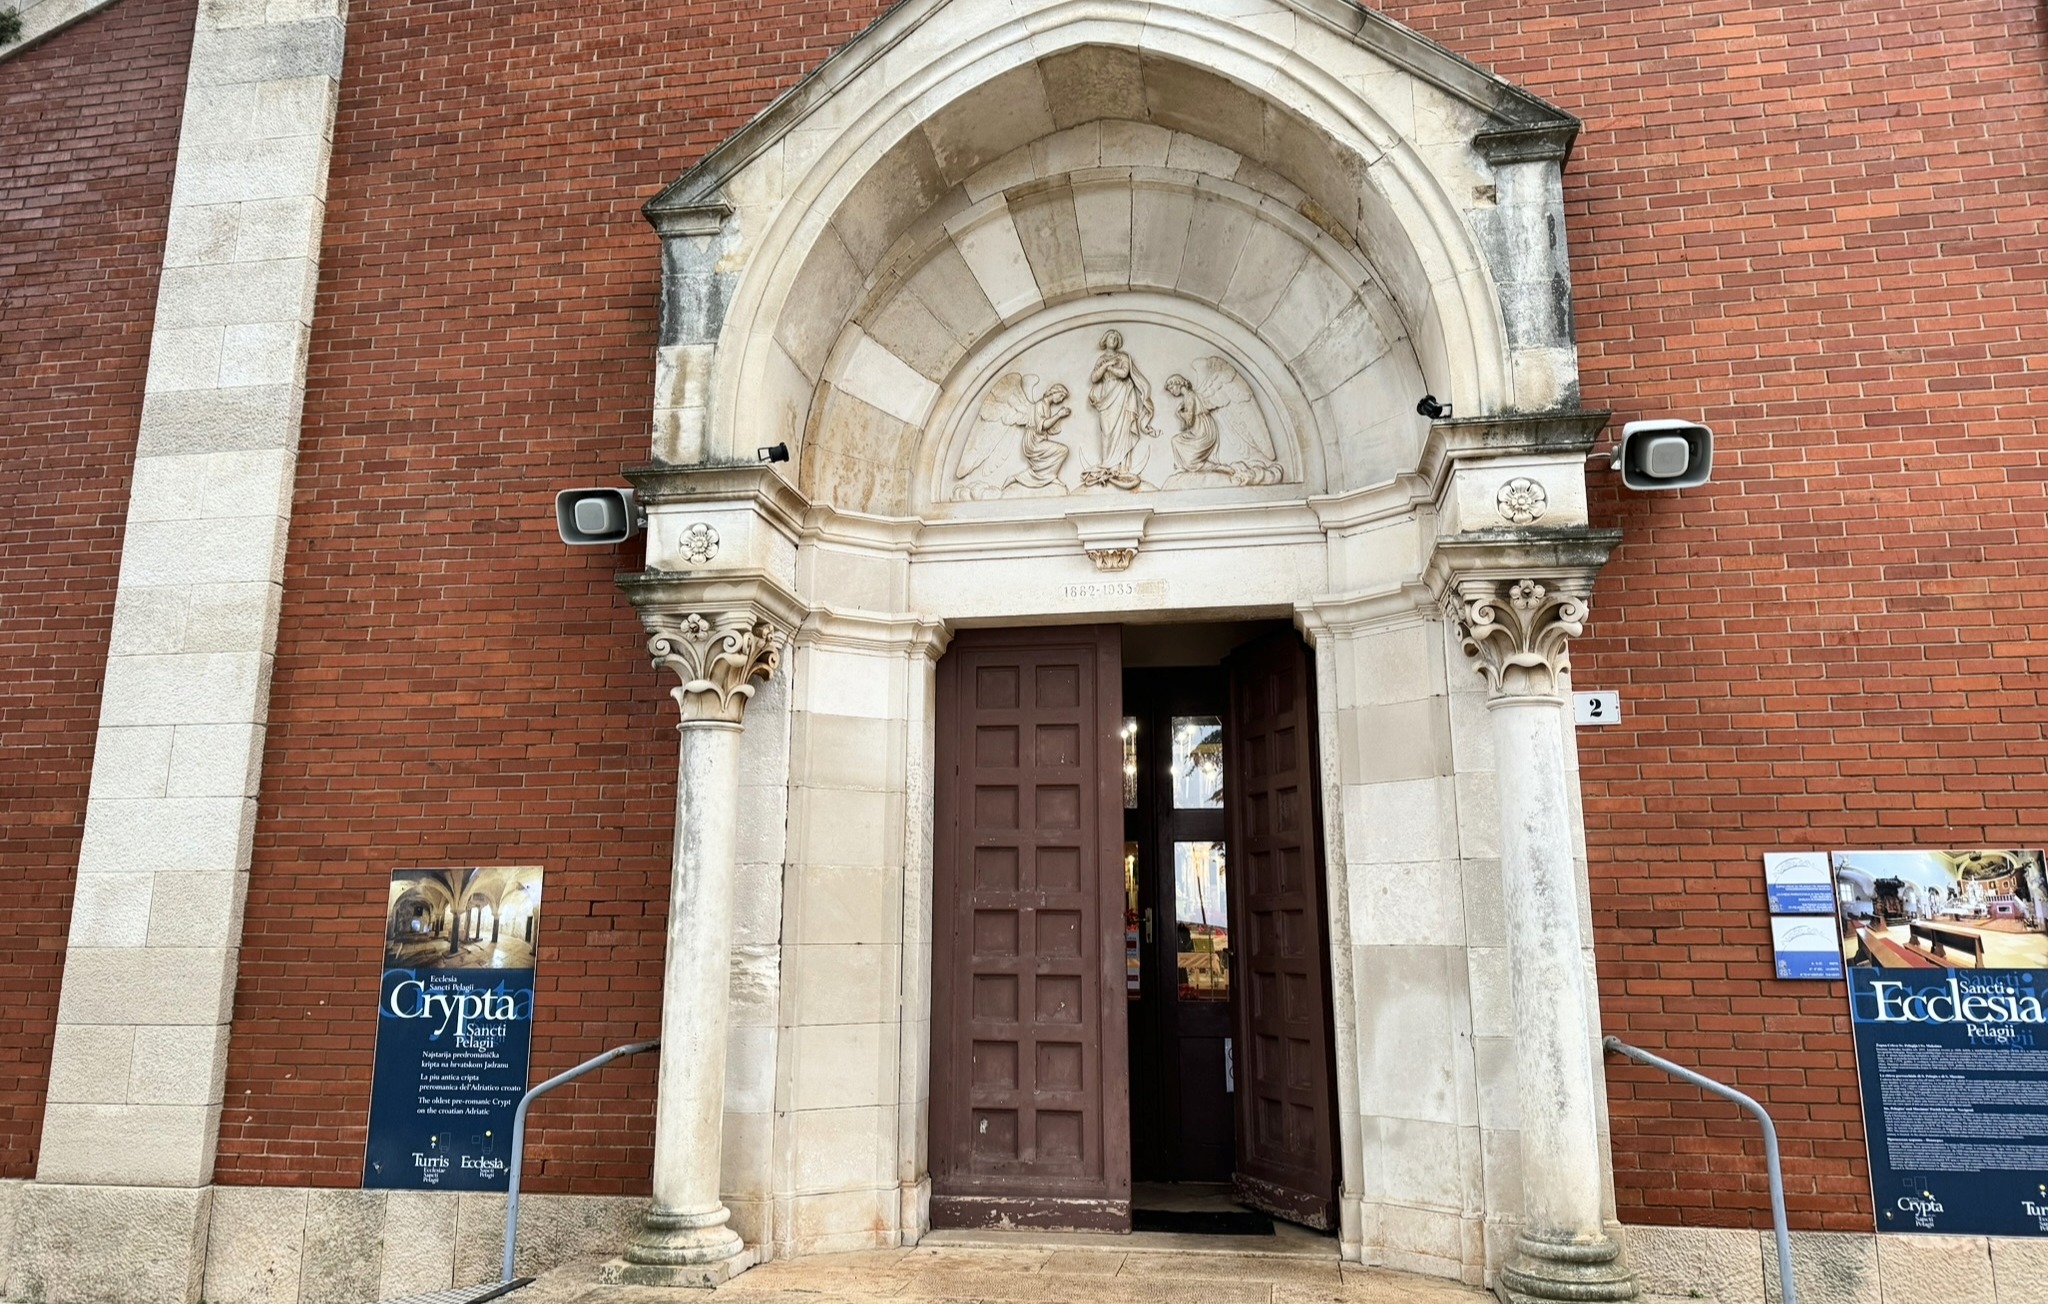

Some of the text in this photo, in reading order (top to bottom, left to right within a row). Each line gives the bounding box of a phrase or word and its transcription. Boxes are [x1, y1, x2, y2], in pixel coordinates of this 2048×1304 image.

[1589, 698, 1603, 718] 2
[430, 975, 458, 983] Ecclesia
[429, 983, 474, 993] Sancti Pelagii
[1960, 980, 2005, 994] Sancti
[391, 980, 517, 1036] Crypta
[1869, 978, 2047, 1024] Ecclesia
[466, 1022, 506, 1037] Sancti
[1967, 1023, 2016, 1043] Pelagii
[456, 1035, 494, 1053] Pelagii
[422, 1051, 500, 1060] Najstarija predromanička
[421, 1060, 440, 1070] kripta
[484, 1061, 509, 1070] Jadranu
[460, 1074, 479, 1083] cripta
[419, 1084, 458, 1092] preromanica
[451, 1098, 491, 1106] pre-romanic
[492, 1098, 511, 1107] Crypt
[465, 1107, 490, 1115] Adriatic
[412, 1152, 450, 1168] Turris
[461, 1155, 504, 1169] Ecclesia
[1897, 1197, 1944, 1217] Crypta
